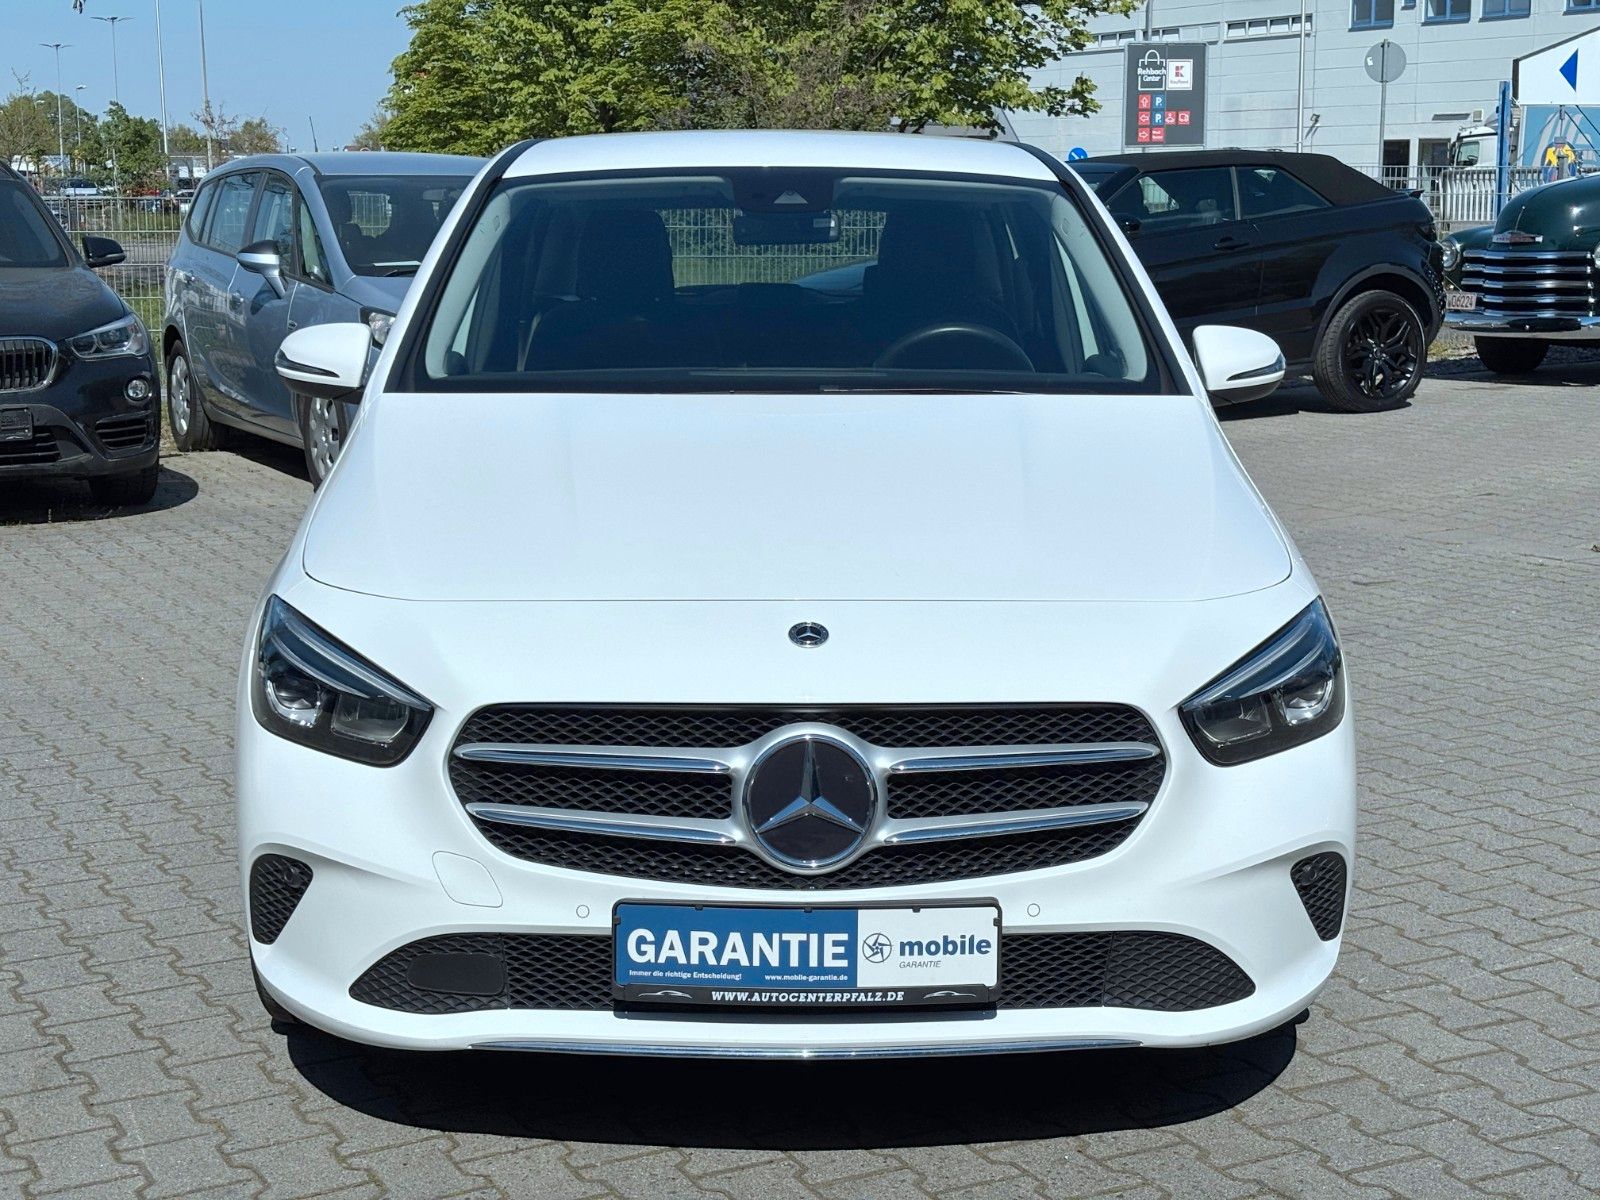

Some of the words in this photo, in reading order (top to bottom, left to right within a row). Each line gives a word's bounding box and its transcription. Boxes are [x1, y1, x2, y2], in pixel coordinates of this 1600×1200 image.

[627, 928, 848, 967] GARANTIE
[899, 934, 992, 957] mobile
[899, 960, 942, 969] GARANTIE
[629, 969, 652, 977] Immer
[652, 970, 664, 978] die
[664, 970, 692, 980] richtige
[693, 971, 743, 981] Entscheidung!
[764, 973, 848, 982] www.mobile-garantie.de
[711, 991, 905, 1003] WWW.AUTOCENTERPFALZ.DE
